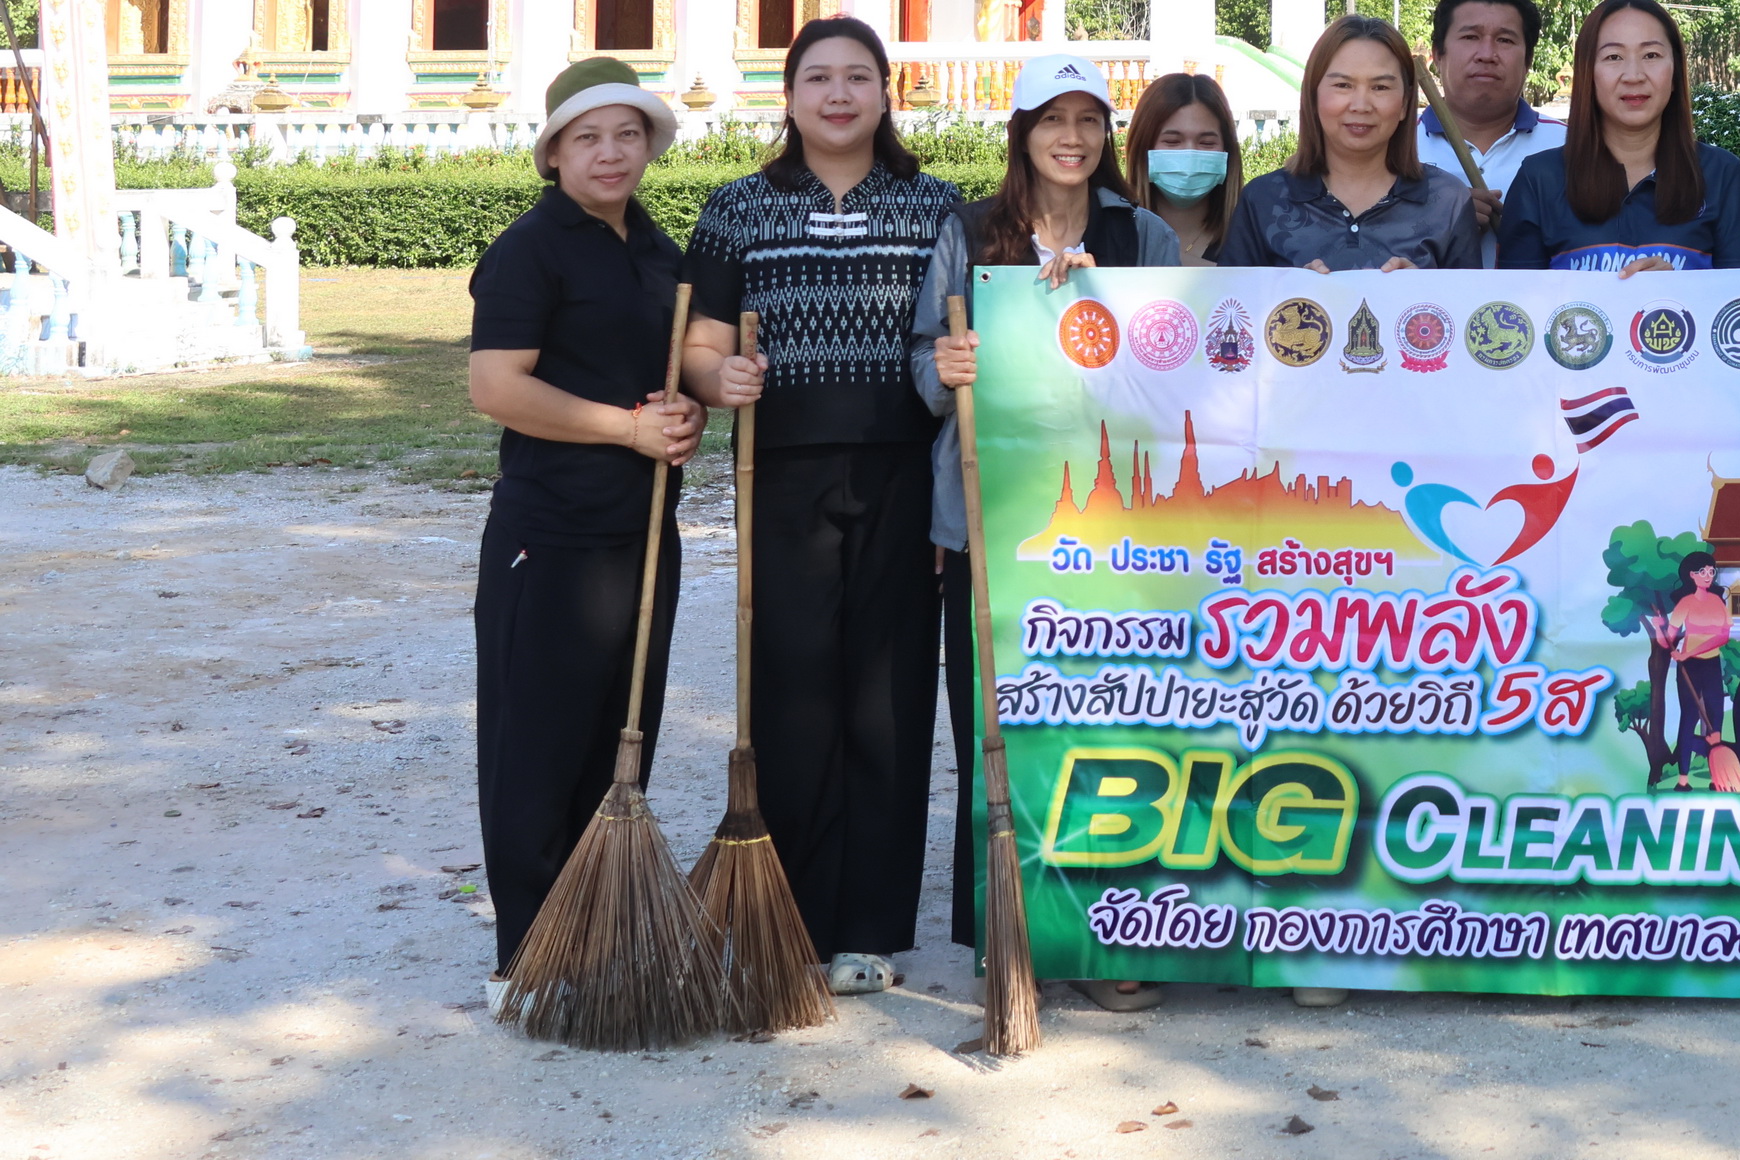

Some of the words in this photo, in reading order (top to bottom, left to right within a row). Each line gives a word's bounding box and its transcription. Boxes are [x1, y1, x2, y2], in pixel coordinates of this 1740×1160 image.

[1054, 72, 1087, 82] adidas
[1624, 349, 1700, 375] กรมการพัฒนาชุมชน
[1052, 537, 1092, 571] วัด
[1111, 539, 1189, 573] ประชา
[1204, 540, 1242, 585] รัฐ
[1256, 539, 1393, 586] สร้างสุขฯ
[1026, 604, 1186, 652] กิจกรรม
[1203, 574, 1529, 666] รวมพลัง
[996, 670, 1319, 743] สร้างสัปปายะสู่วัด
[1331, 678, 1475, 727] ด้วยวิถี
[1049, 752, 1351, 870] BIG
[1092, 886, 1233, 946] จัดโดย
[1246, 904, 1547, 955] กองการศึกษา
